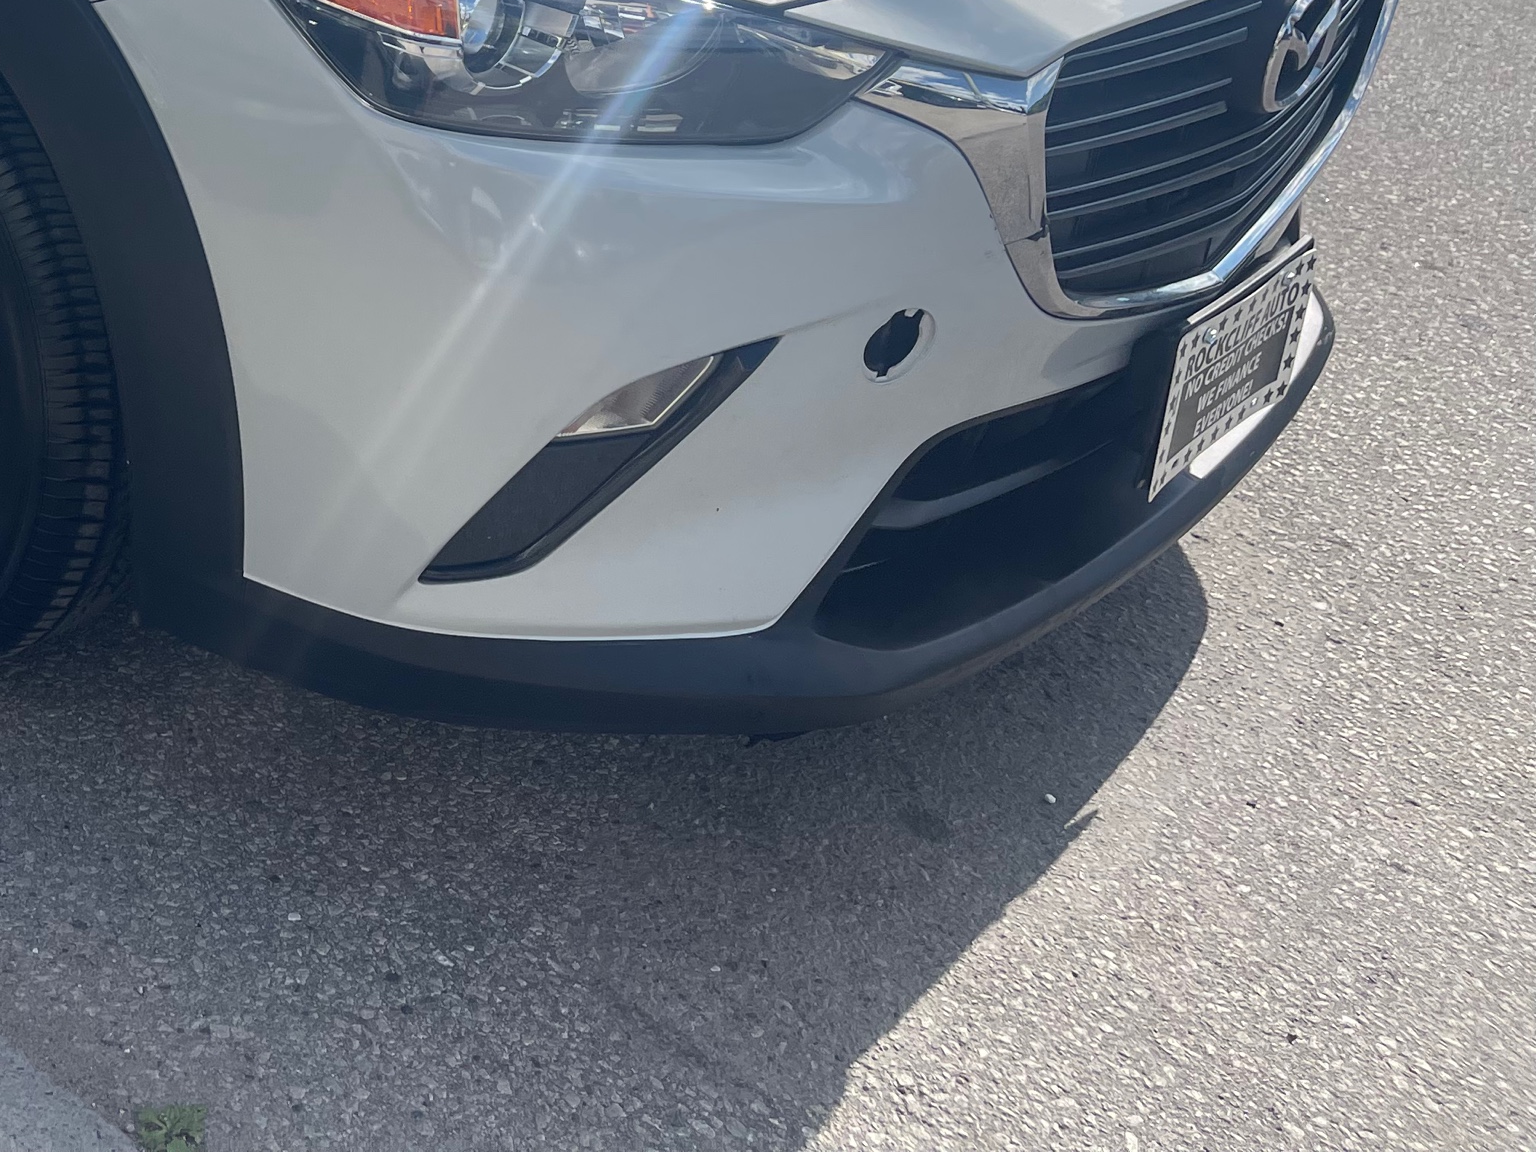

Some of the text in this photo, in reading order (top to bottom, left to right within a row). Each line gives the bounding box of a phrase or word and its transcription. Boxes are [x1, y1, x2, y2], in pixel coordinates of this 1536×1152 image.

[1184, 312, 1288, 401] NO CREDIT CHECKS!
[1185, 282, 1300, 380] ROCKCLIFF AUTO
[1193, 379, 1255, 437] EVERYONE!
[1196, 351, 1263, 414] WE FINANCE
